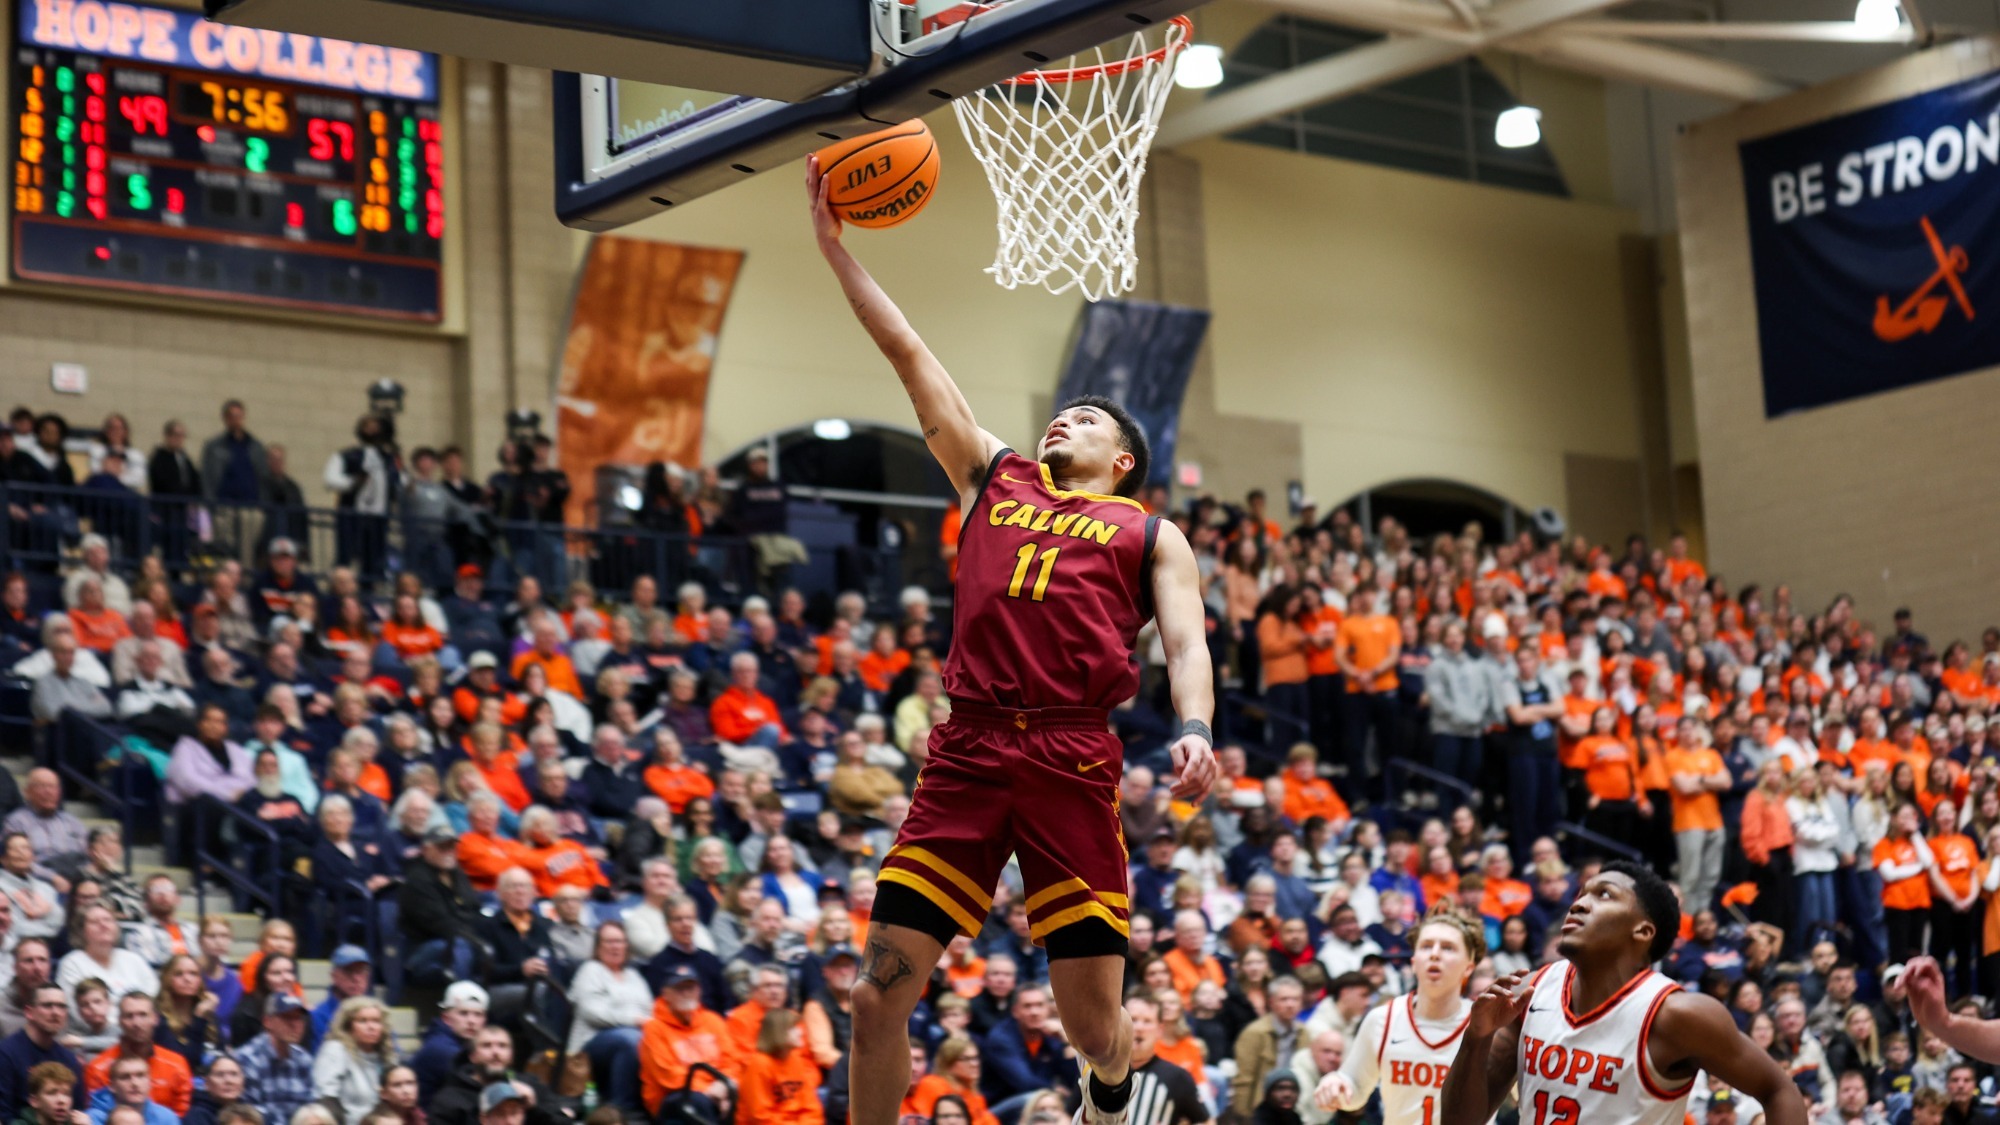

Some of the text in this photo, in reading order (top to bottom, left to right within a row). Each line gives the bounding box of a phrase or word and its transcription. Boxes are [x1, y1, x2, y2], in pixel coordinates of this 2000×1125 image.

[34, 0, 425, 99] HOPE COLLEGE
[119, 96, 168, 136] 49
[201, 81, 288, 132] 7:56
[245, 137, 269, 173] 2
[308, 118, 354, 161] 57
[128, 174, 152, 210] 5
[847, 154, 892, 190] EVO
[1771, 162, 1826, 224] BE
[848, 179, 929, 221] Wilson
[988, 499, 1122, 546] CALVIN
[1007, 542, 1061, 603] 11
[1390, 1060, 1450, 1089] HOP
[1524, 1034, 1624, 1095] HOPE
[1534, 1089, 1581, 1125] 12
